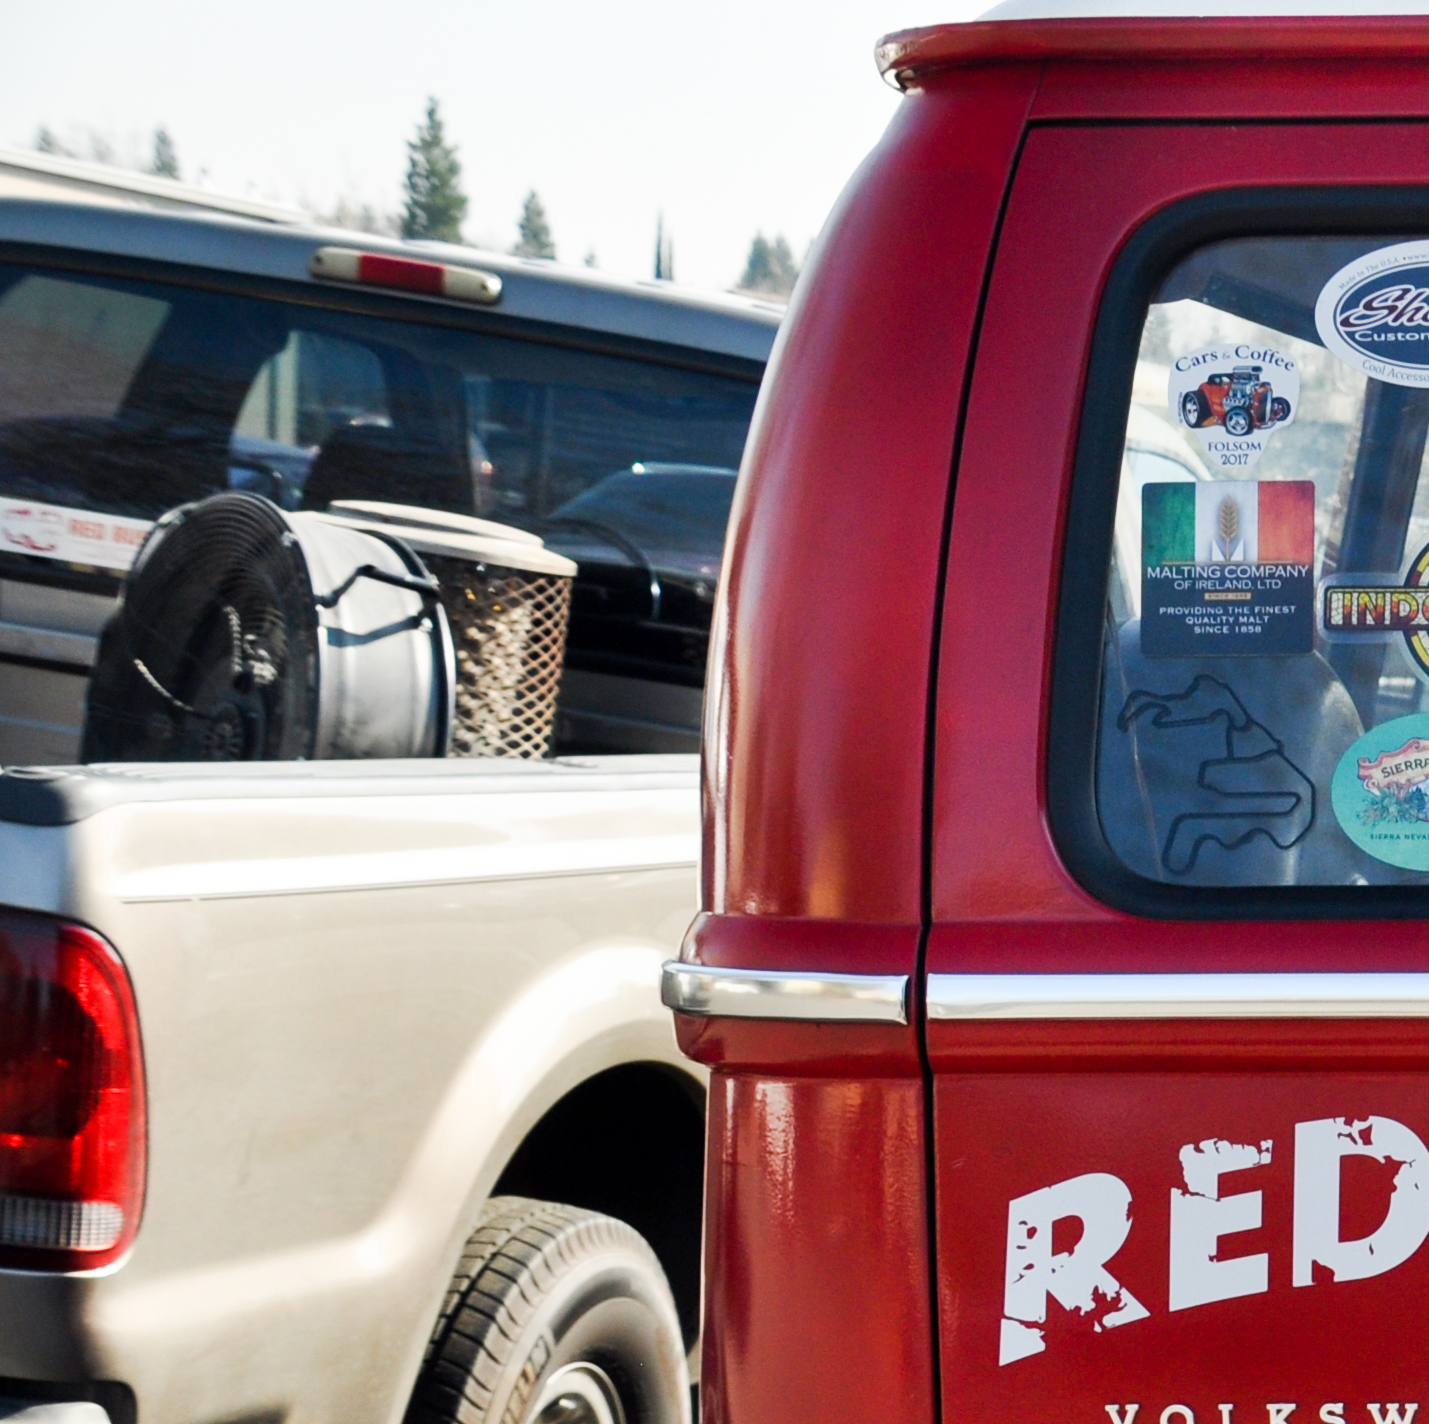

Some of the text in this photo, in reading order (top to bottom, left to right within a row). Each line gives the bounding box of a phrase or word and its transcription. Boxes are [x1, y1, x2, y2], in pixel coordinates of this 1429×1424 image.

[1175, 345, 1295, 372] Cars & Coffee
[1362, 359, 1386, 376] Cool
[1208, 441, 1262, 452] FOLSOM
[1221, 454, 1249, 465] 2017
[1147, 565, 1310, 580] MALTING COMPANY
[1174, 581, 1193, 590] OF
[1257, 580, 1282, 590] LTD
[1159, 605, 1297, 615] PROVIDING THE FINEST
[1185, 615, 1270, 624] QUALITY MALT
[1194, 625, 1262, 634] SINCE 1858
[1370, 833, 1401, 841] SIERRA
